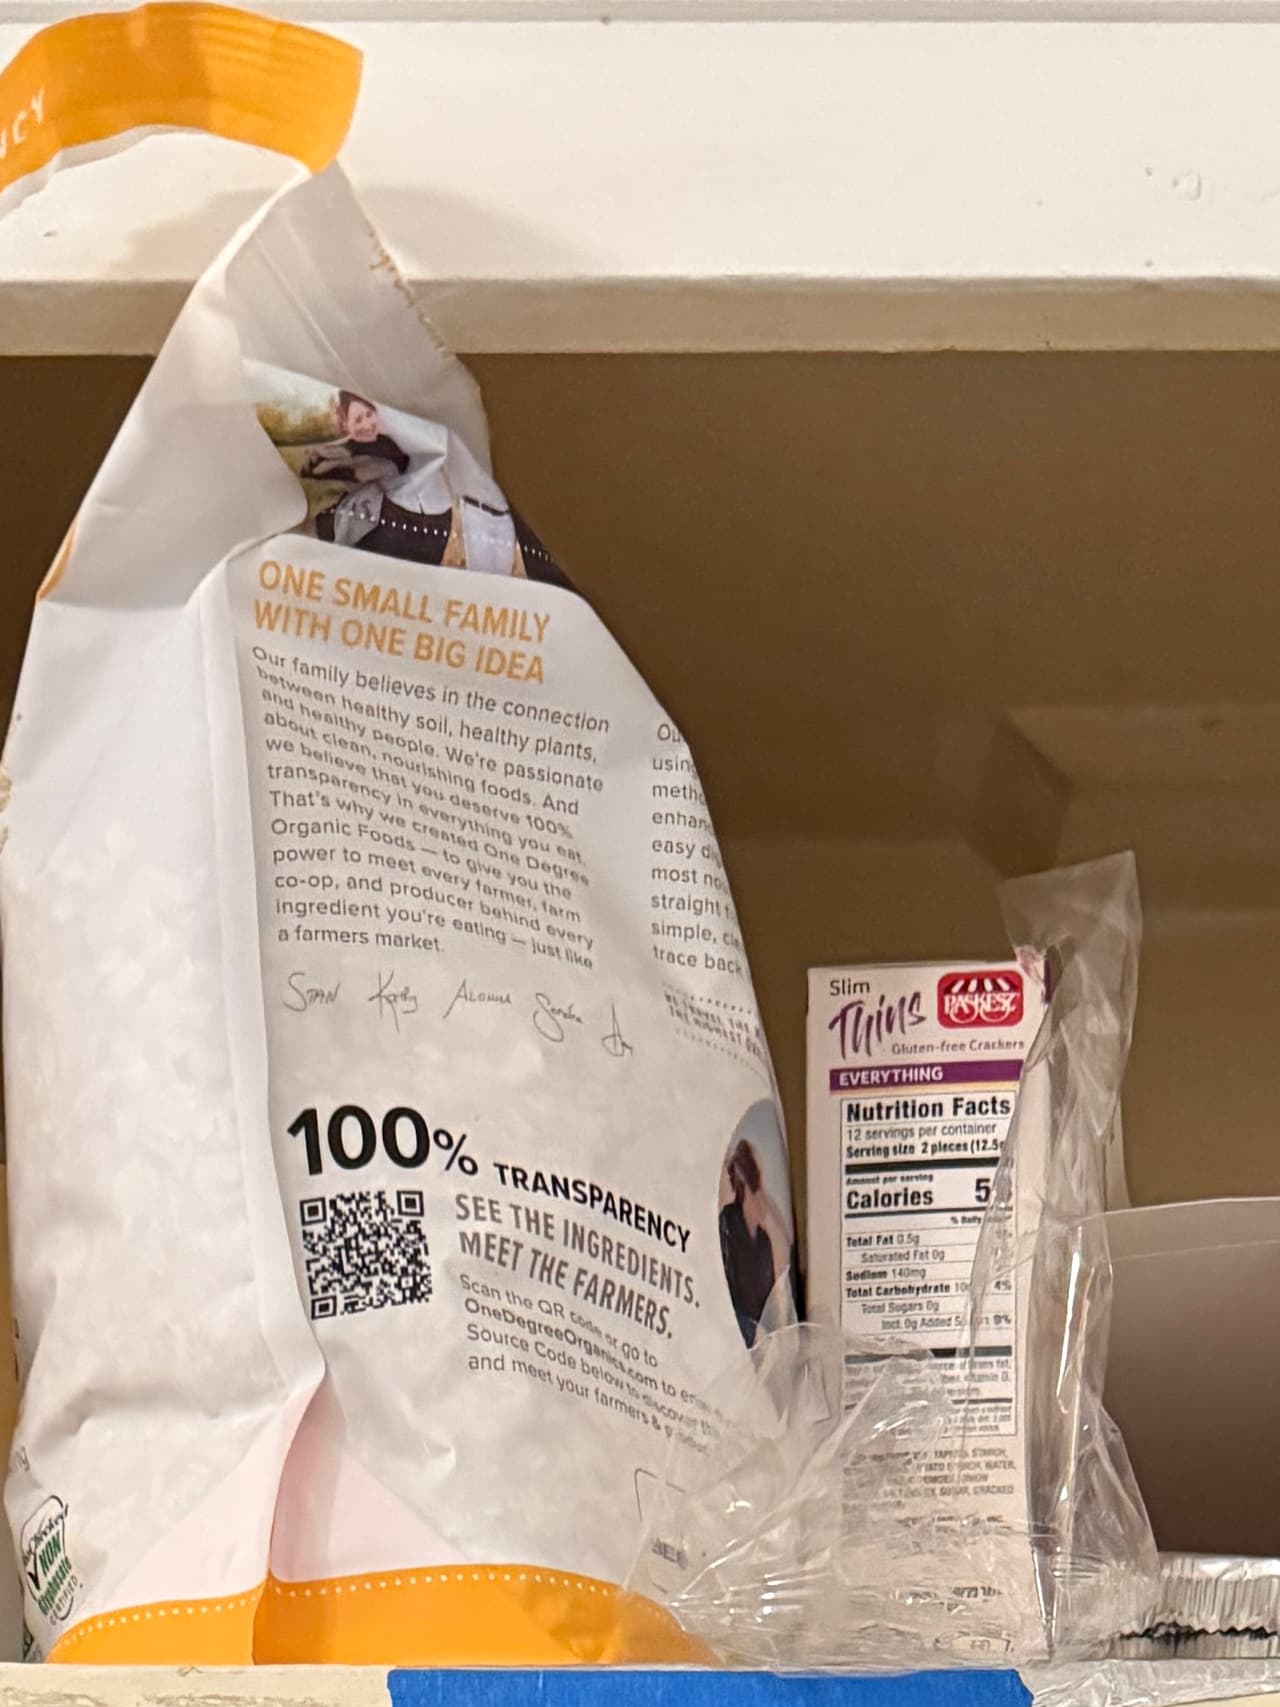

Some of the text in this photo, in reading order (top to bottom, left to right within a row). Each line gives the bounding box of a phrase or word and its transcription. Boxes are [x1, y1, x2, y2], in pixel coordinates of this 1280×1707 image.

[254, 598, 545, 684] WITH ONE BIG IDEA
[258, 560, 550, 643] ONE SMALL FAMILY
[252, 646, 610, 734] Our family believes in the connection
[256, 665, 598, 766] between healthy soil, healthy plants,
[828, 978, 927, 1061] Slim Thins
[891, 1037, 1024, 1056] Gluten-free Crackers
[840, 1066, 944, 1087] EVERYTHING
[846, 1096, 1011, 1123] Nutrition Facts
[848, 1122, 997, 1142] 12 servings per container
[286, 1104, 691, 1254] 100% TRANSPARENCY
[846, 1186, 934, 1210] Calories
[456, 1193, 700, 1308] SEE THE INGREDIENTS.
[458, 1231, 672, 1339] MEET THE FARMERS.
